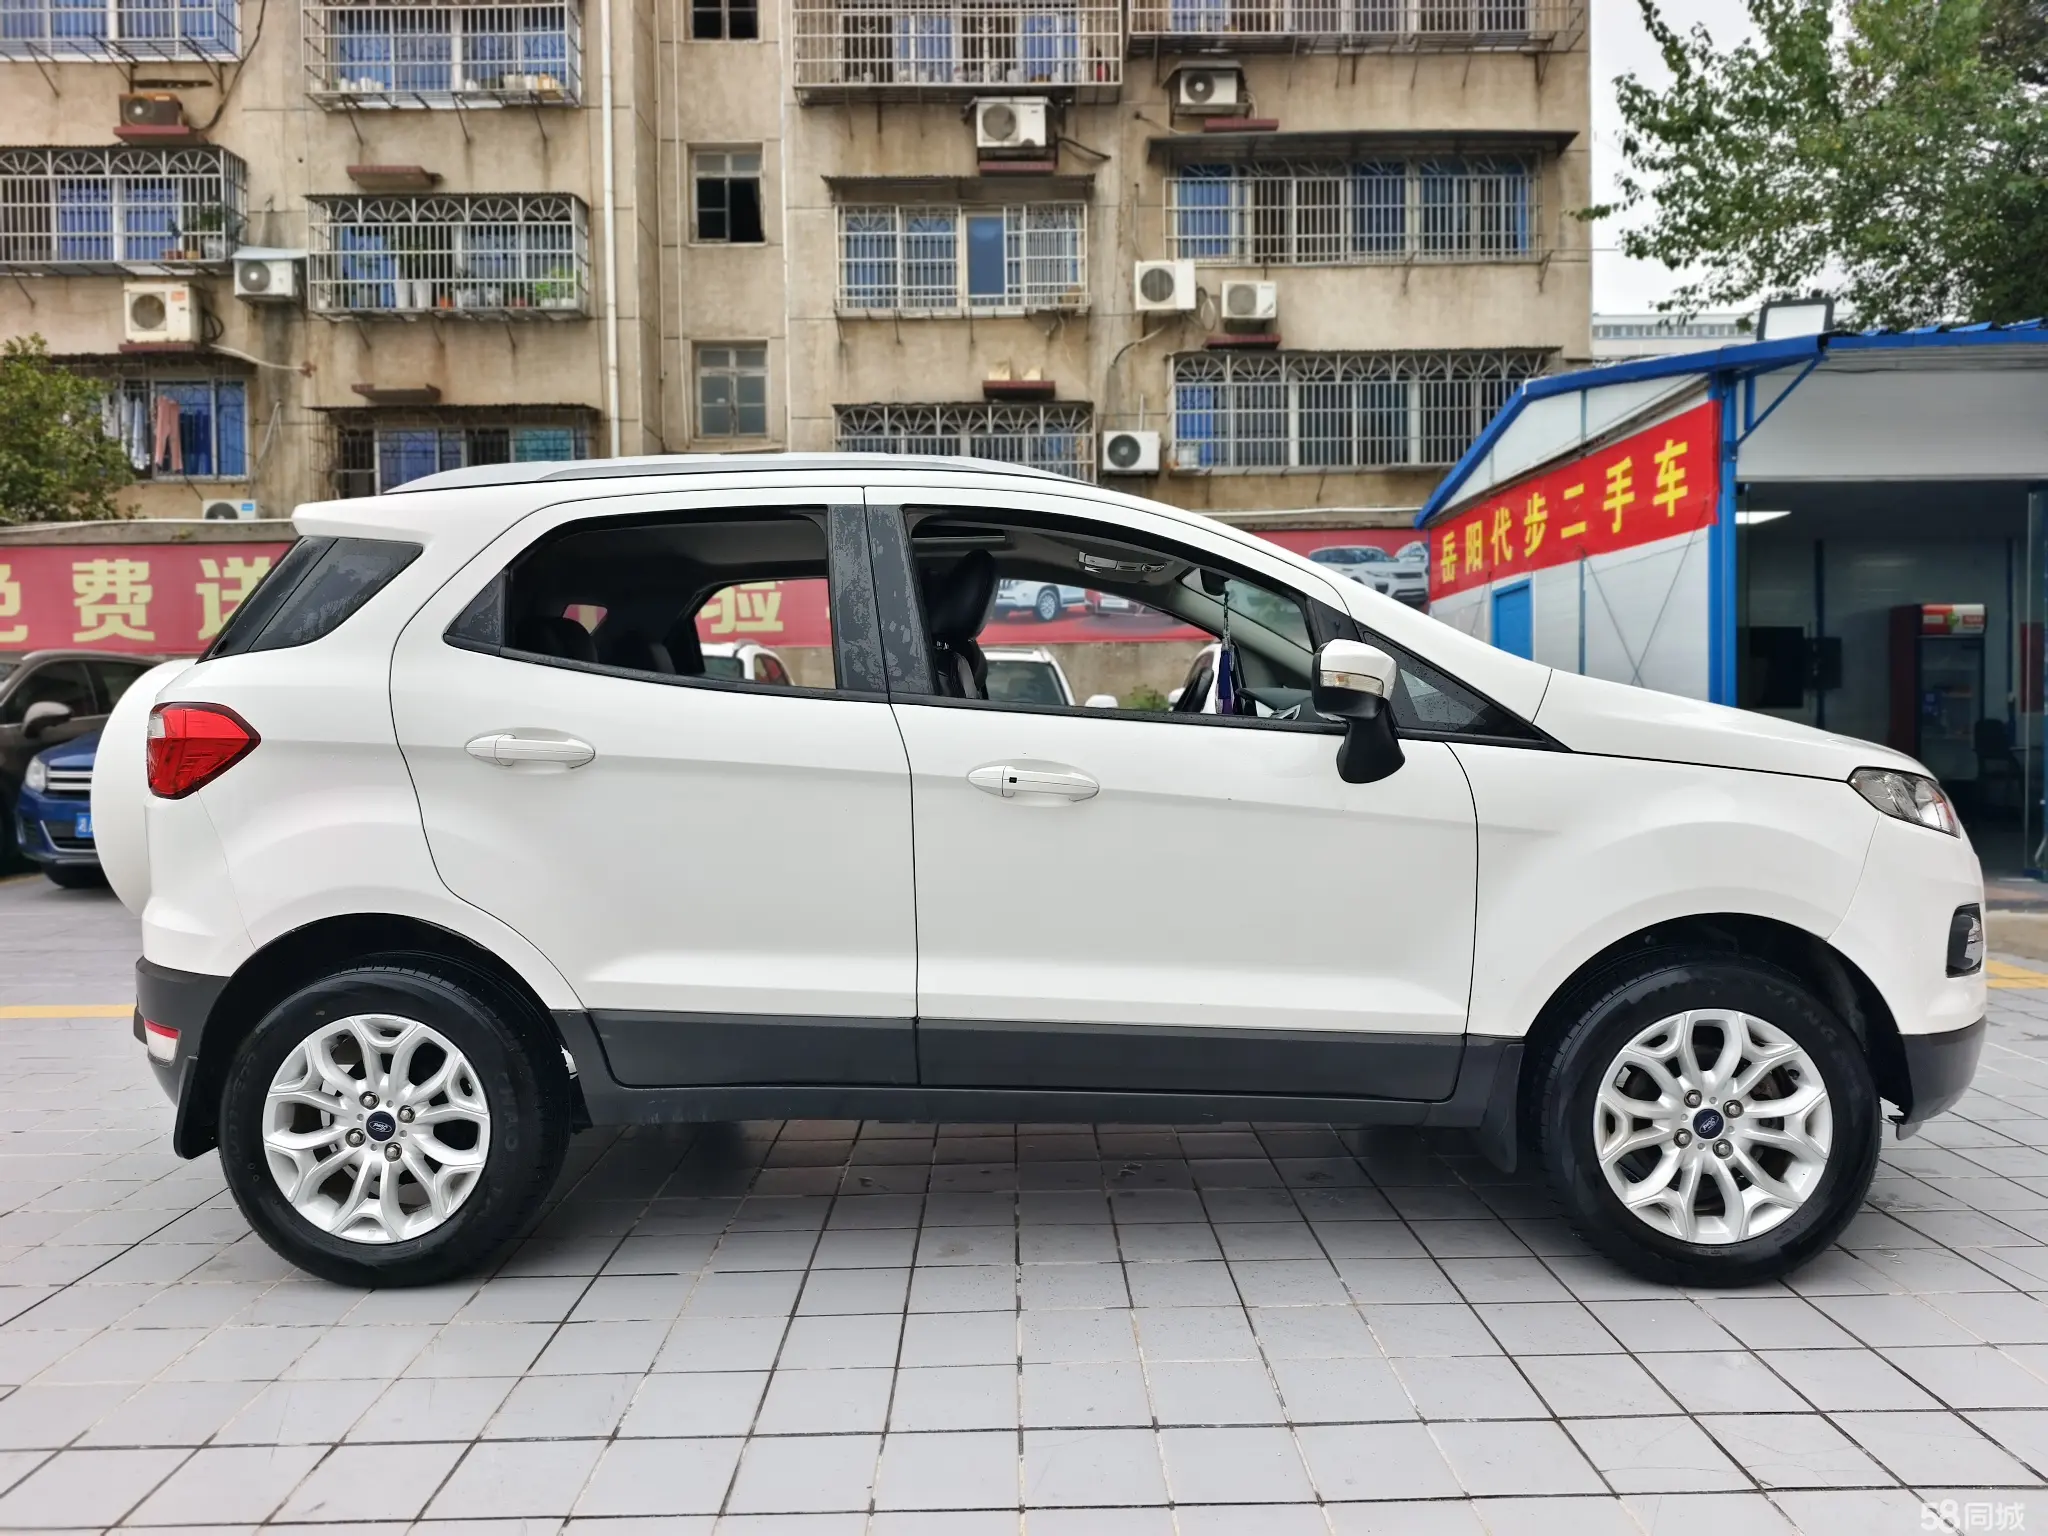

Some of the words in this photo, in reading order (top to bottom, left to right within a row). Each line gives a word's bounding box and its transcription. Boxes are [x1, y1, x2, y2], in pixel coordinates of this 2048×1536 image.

[1440, 439, 1689, 583] 岳阳代步二手车
